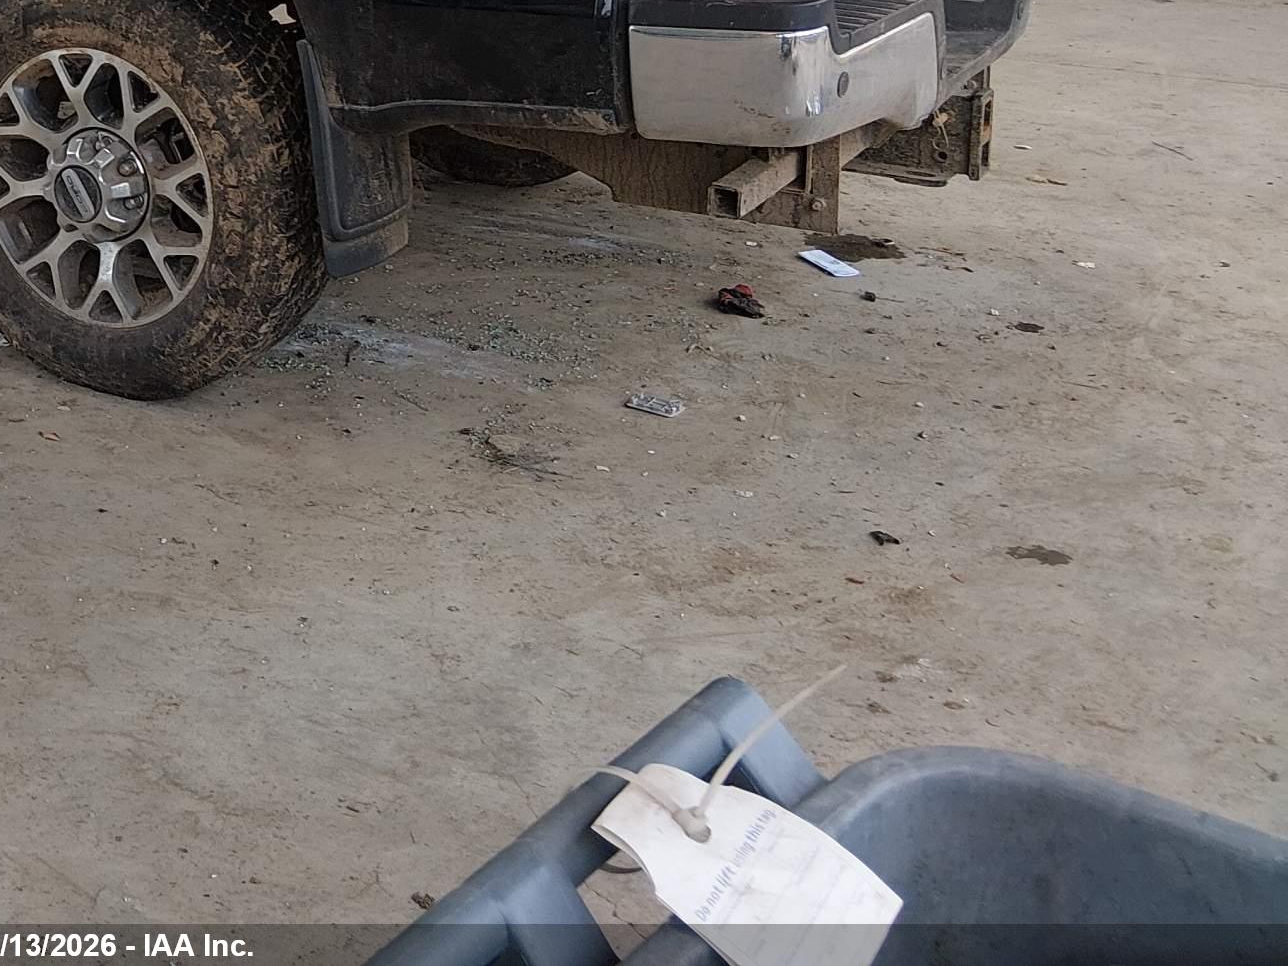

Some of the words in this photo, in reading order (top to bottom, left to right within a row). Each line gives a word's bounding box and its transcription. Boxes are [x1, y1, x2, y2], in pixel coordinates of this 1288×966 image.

[694, 905, 710, 922] Do
[706, 886, 724, 906] not
[715, 866, 736, 888] lift
[732, 841, 756, 867] using
[744, 823, 765, 842] this
